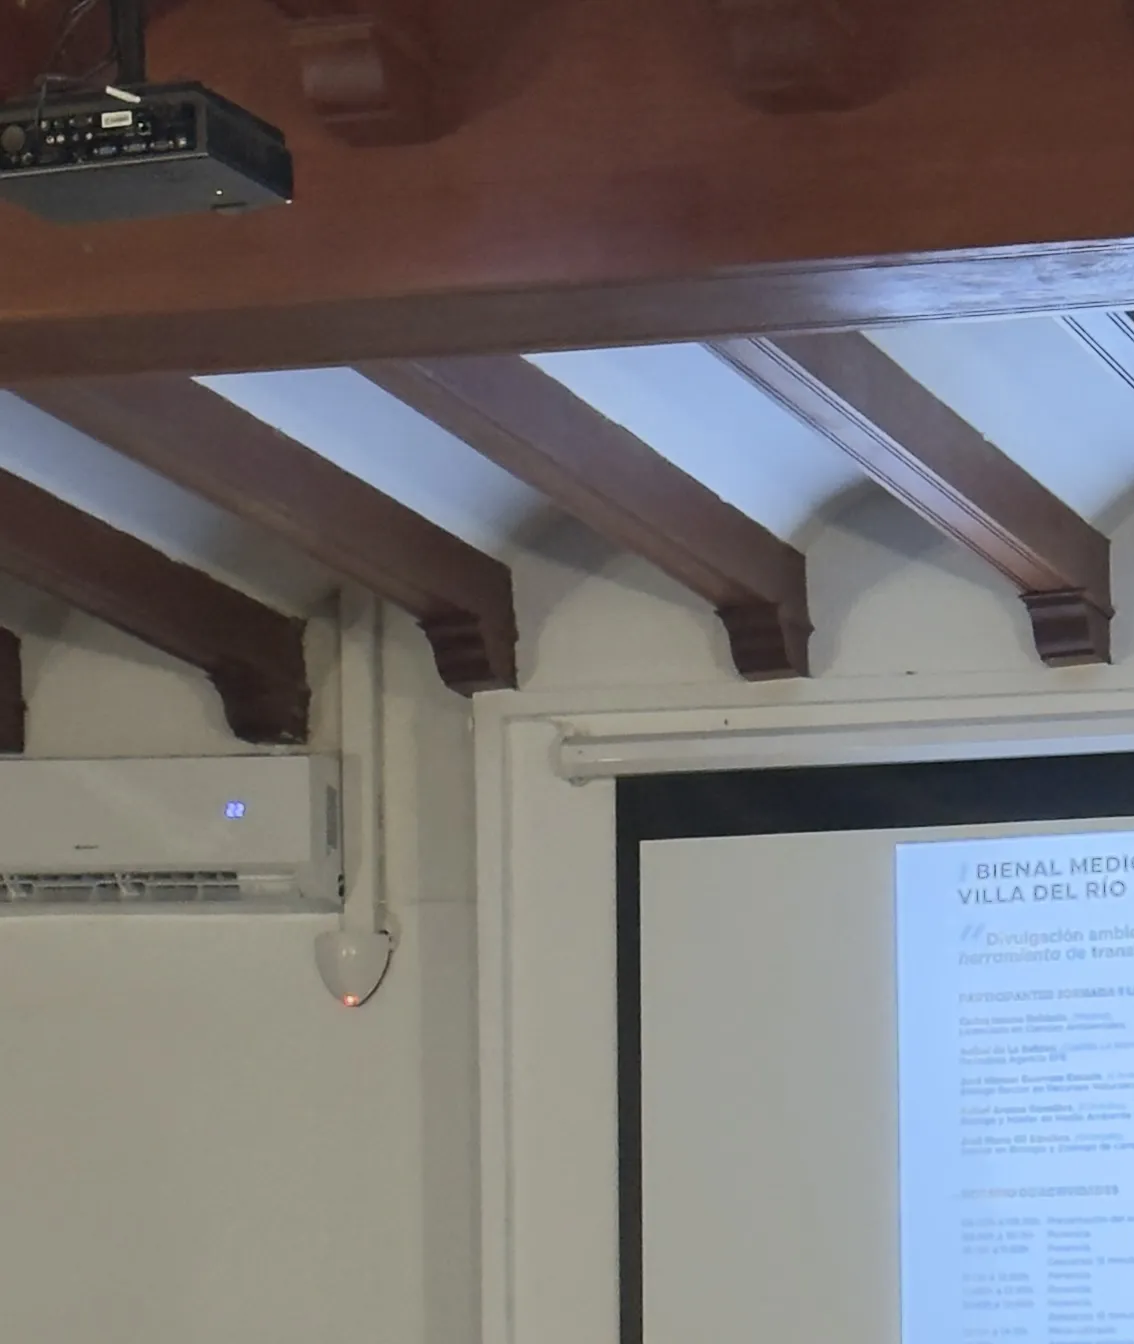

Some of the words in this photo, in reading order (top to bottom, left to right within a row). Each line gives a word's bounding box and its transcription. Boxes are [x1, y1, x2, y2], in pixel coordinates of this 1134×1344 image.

[976, 860, 1062, 880] BIENAL
[957, 884, 1026, 905] VILLA
[1033, 883, 1078, 902] DEL
[1086, 876, 1128, 899] RÍO
[986, 929, 1084, 948] Divulgación
[957, 946, 1062, 966] herramienta
[1065, 945, 1087, 961] de
